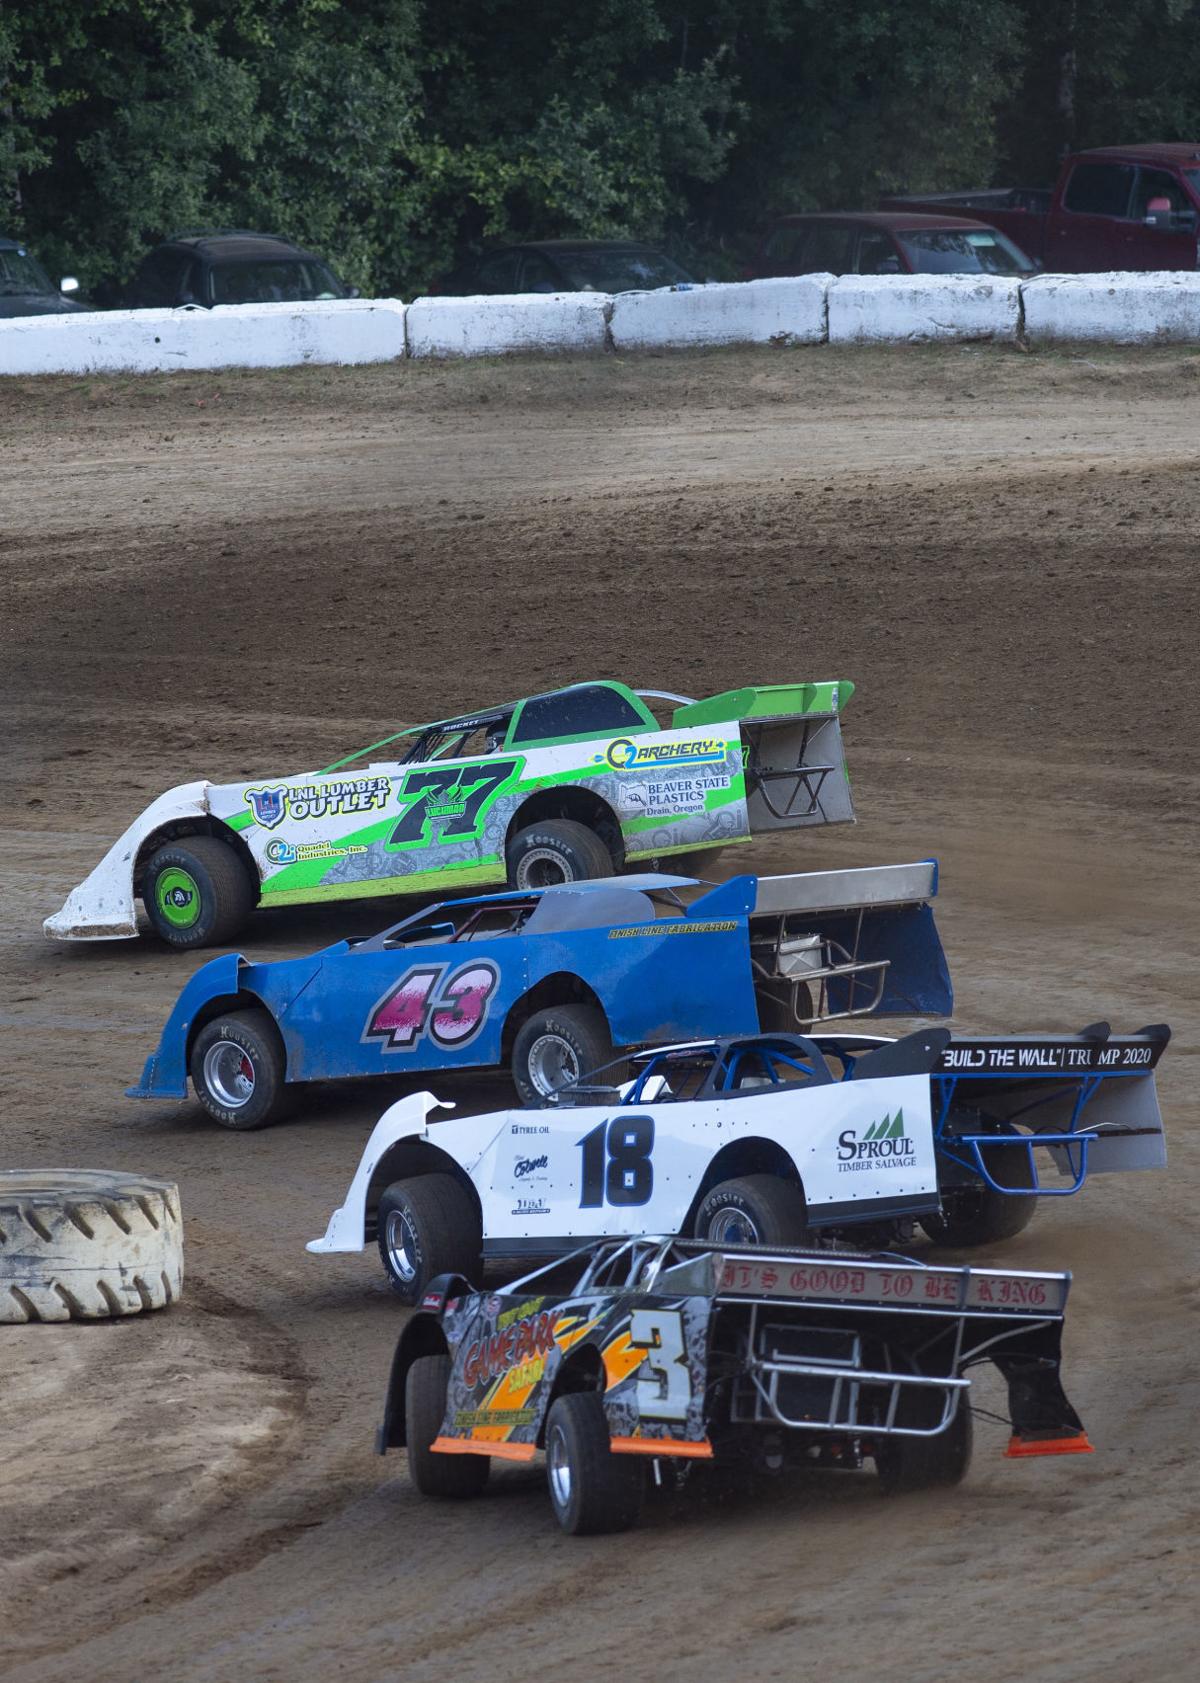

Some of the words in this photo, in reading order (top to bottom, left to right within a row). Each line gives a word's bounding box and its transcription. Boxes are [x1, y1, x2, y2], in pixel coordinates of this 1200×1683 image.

[637, 740, 713, 761] ARCHERY
[288, 787, 317, 801] LNL
[320, 777, 389, 798] LUMBER
[648, 780, 692, 794] BEAVER
[695, 776, 729, 789] STATE
[289, 788, 391, 820] OUTLET
[386, 757, 523, 850] 77
[649, 790, 704, 806] PLASTICS
[646, 807, 671, 816] Drain,
[673, 803, 704, 814] Oregon
[348, 845, 368, 853] Inc.
[363, 960, 500, 1051] 43
[989, 1049, 1016, 1067] THE
[1123, 1047, 1152, 1065] 2020
[519, 1126, 538, 1135] TYREE
[538, 1125, 550, 1134] OIL
[837, 1129, 915, 1161] SPROUL
[575, 1115, 656, 1209] 18
[837, 1160, 873, 1173] TIMBER
[875, 1157, 917, 1169] SALVAGE
[722, 1264, 779, 1289] IT'S
[789, 1269, 866, 1294] GOOD
[878, 1273, 914, 1298] TO
[925, 1275, 959, 1300] BE
[976, 1279, 1047, 1305] KING
[630, 1308, 692, 1424] 3
